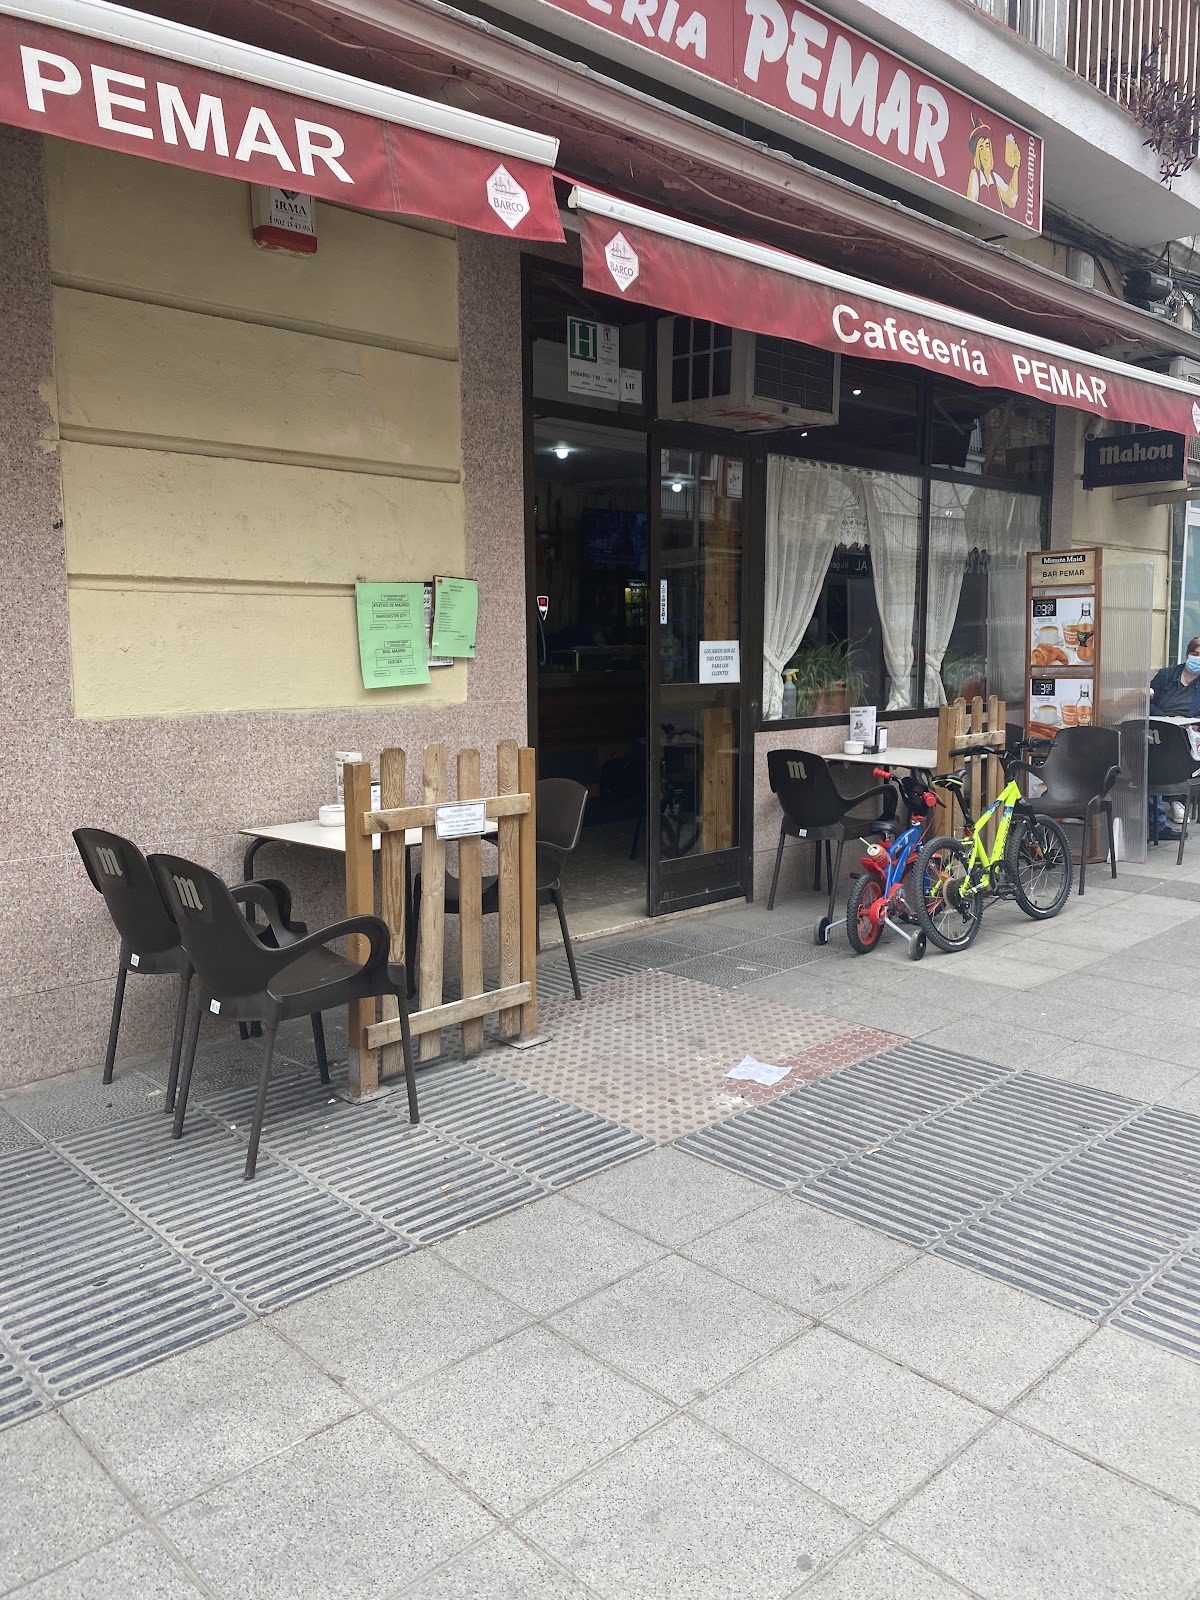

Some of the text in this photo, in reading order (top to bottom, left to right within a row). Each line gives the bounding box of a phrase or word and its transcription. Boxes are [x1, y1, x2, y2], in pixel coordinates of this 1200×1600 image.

[19, 44, 356, 185] PEMAR
[743, 0, 950, 178] PEMAR
[493, 197, 524, 212] BARCO
[1024, 136, 1036, 226] Cruzcampo
[610, 262, 634, 277] BARCO
[572, 321, 597, 360] H
[831, 304, 1108, 408] Cafetería PEMAR
